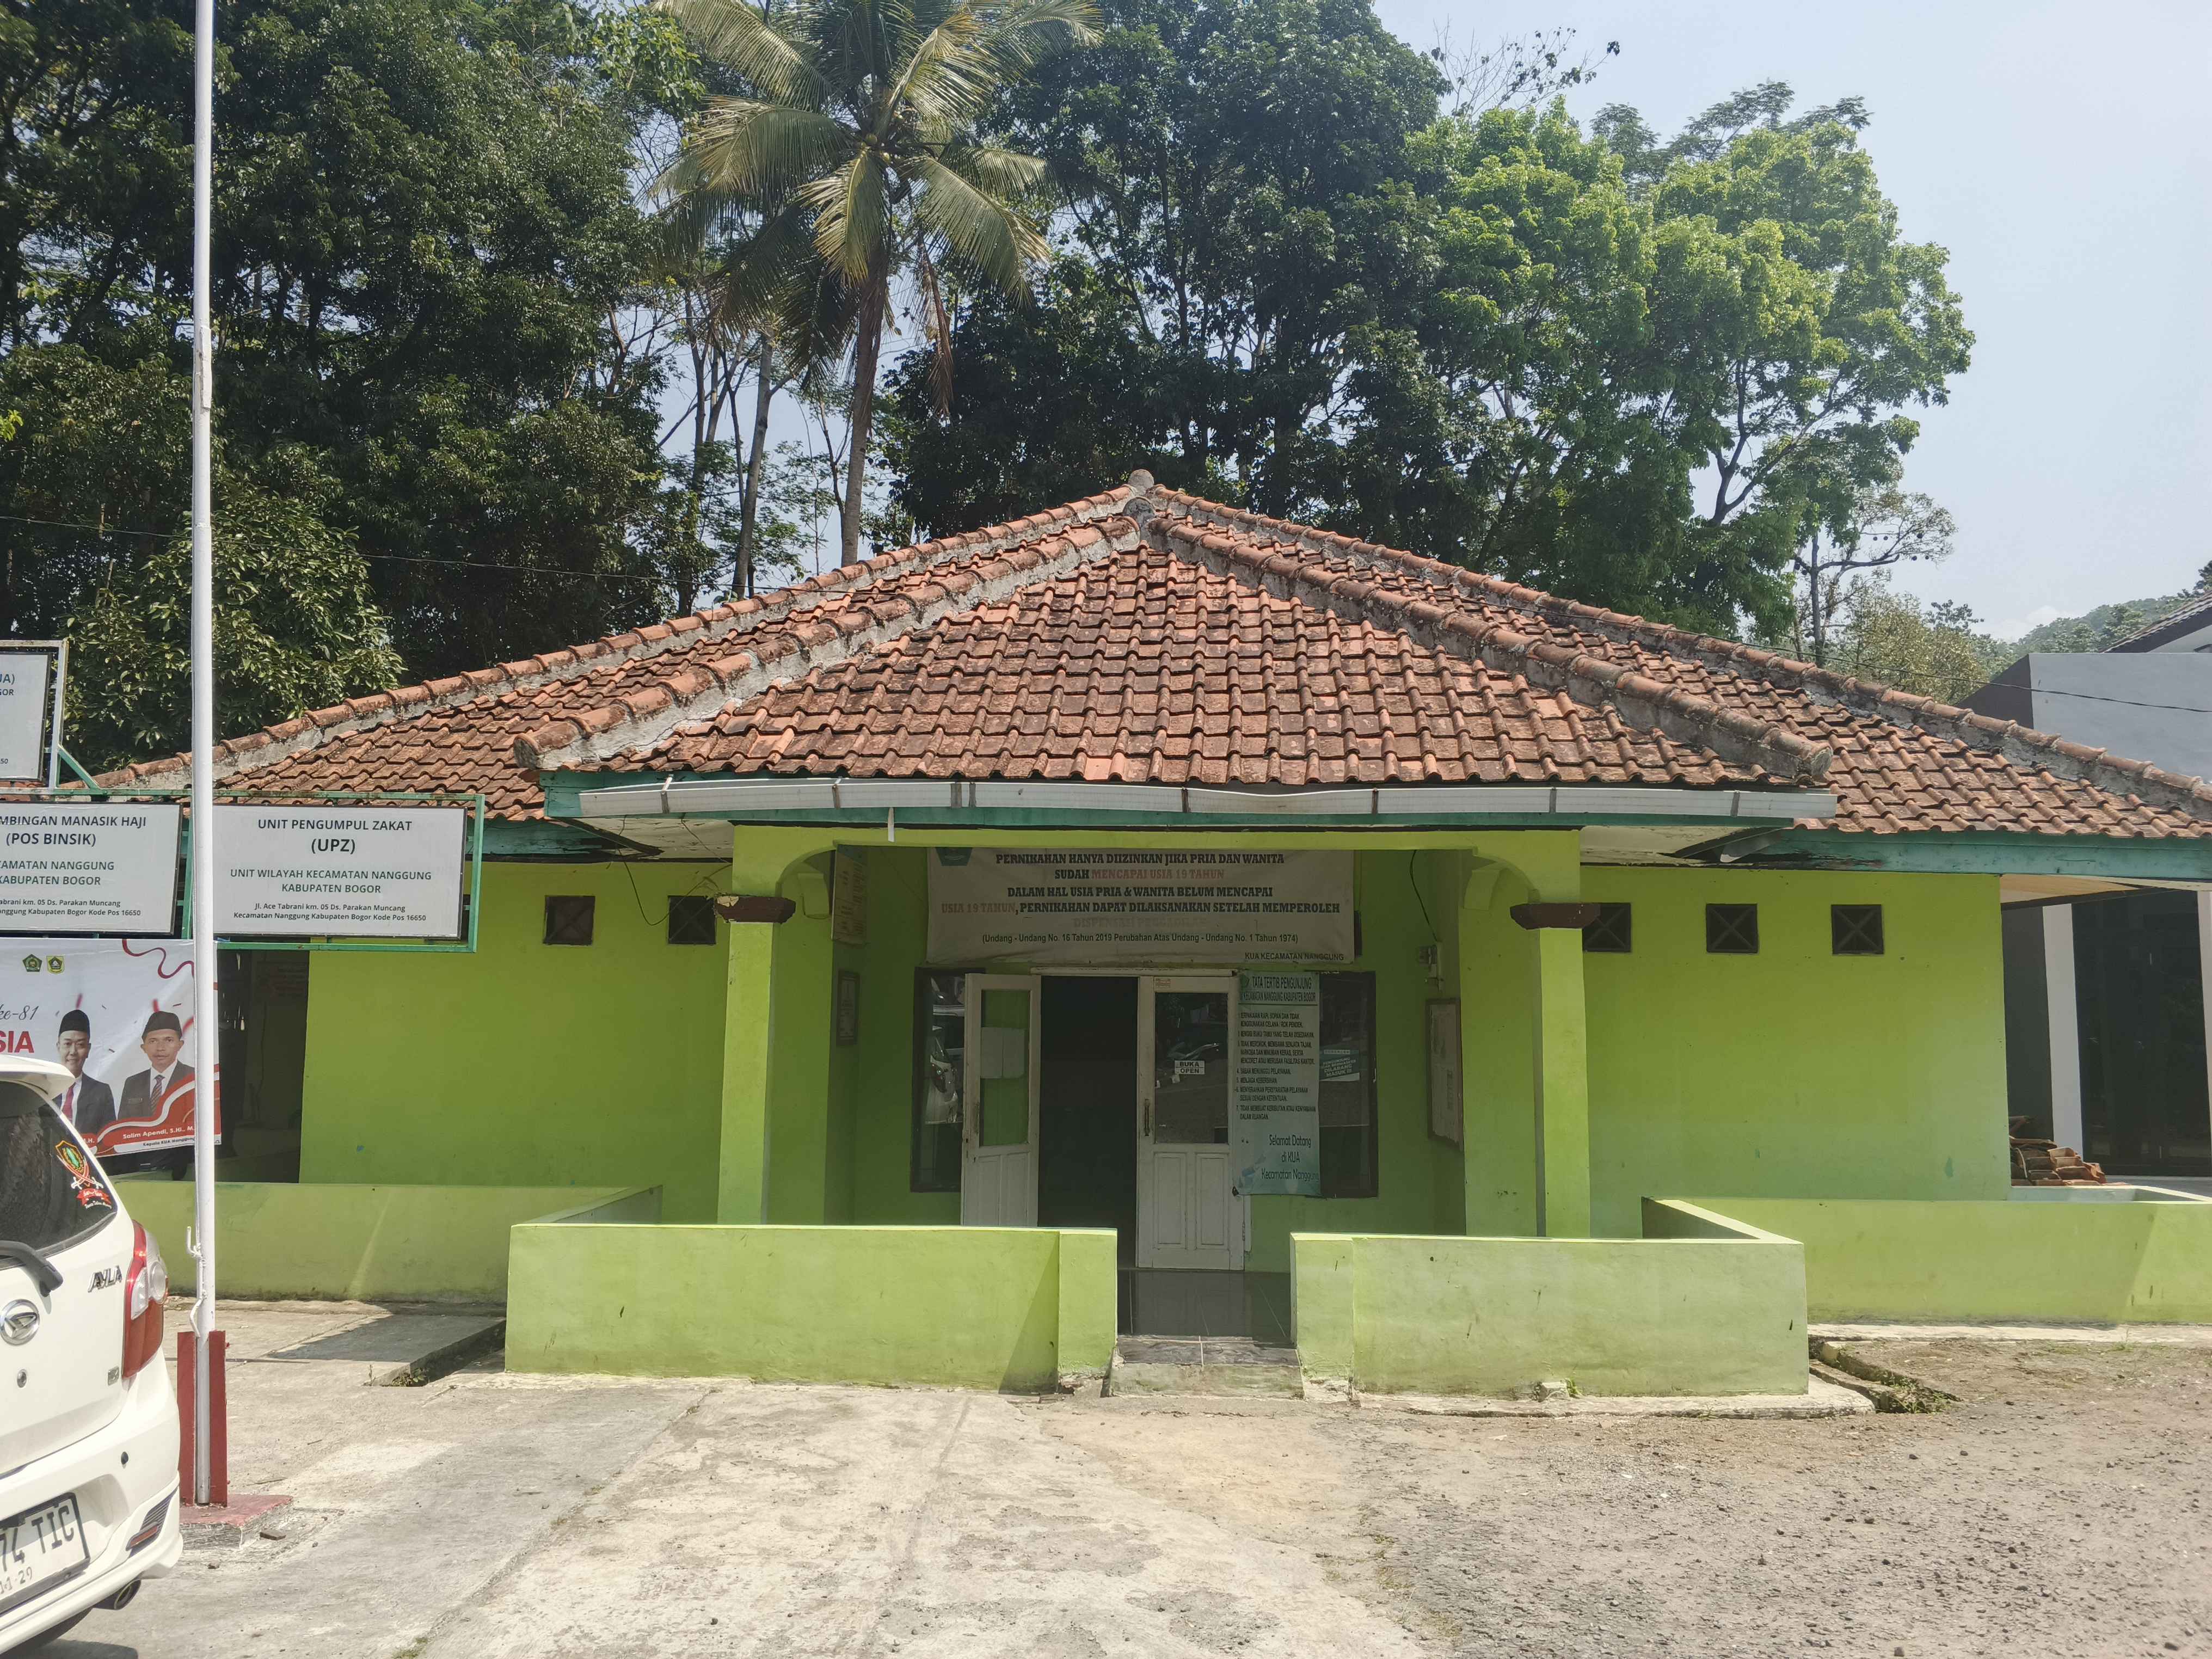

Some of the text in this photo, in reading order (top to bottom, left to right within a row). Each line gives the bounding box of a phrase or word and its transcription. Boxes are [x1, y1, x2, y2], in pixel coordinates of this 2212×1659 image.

[62, 816, 118, 826] MANASIK
[121, 817, 146, 829] HAJI
[258, 819, 412, 831] UNIT PENGUMPUL ZAKAT
[6, 833, 96, 847] (POS BINSIK)
[311, 838, 355, 855] (UPZ)
[996, 854, 1285, 865] PERNIKAHAN HANYA DIIZINKAN JIKA PRIA DAN WANITA
[0, 861, 114, 870] AMATAN NANGGUNG
[230, 869, 432, 880] UNIT WILAYAH KECAMATAN NANGGUNG
[1054, 870, 1224, 880] SUDAH MENCAPAI USIA 19 TAHUN
[63, 876, 101, 886] BOGOR
[282, 884, 381, 893] KABUPATEN BOGOR
[1007, 887, 1273, 897] DALAM HAL USIA PRIA & WANITA BELUM MENCAPAI
[67, 909, 87, 917] Bogor
[374, 905, 405, 913] Muncang
[941, 903, 964, 913] USIA
[967, 903, 979, 913] 19
[1019, 903, 1090, 913] PERNIKAHAN
[1092, 903, 1127, 913] DAPAT
[1129, 903, 1211, 913] DILAKSANAKAN
[1213, 903, 1260, 913] SETELAH
[1262, 903, 1340, 913] MEMPEROLEH
[274, 912, 310, 920] Nanggung
[311, 913, 349, 921] Kabupaten
[982, 934, 1012, 944] (Undang
[1019, 934, 1046, 943] Undang
[1171, 934, 1200, 943] Undang
[1206, 934, 1233, 943] Undang
[1235, 934, 1246, 942] No.
[1249, 934, 1252, 942] 1
[1255, 934, 1277, 942] Tahun
[1280, 934, 1298, 944] 1974)
[1304, 953, 1344, 961] NANGGUNG
[1252, 976, 1312, 990] TATA TERTIB PENGUNJUNG
[1269, 1134, 1311, 1148] Selamat Datang
[1281, 1152, 1300, 1163] di KUA
[1262, 1168, 1292, 1180] Kecamatan
[88, 1265, 122, 1293] AYLA
[31, 1506, 74, 1554] TIC
